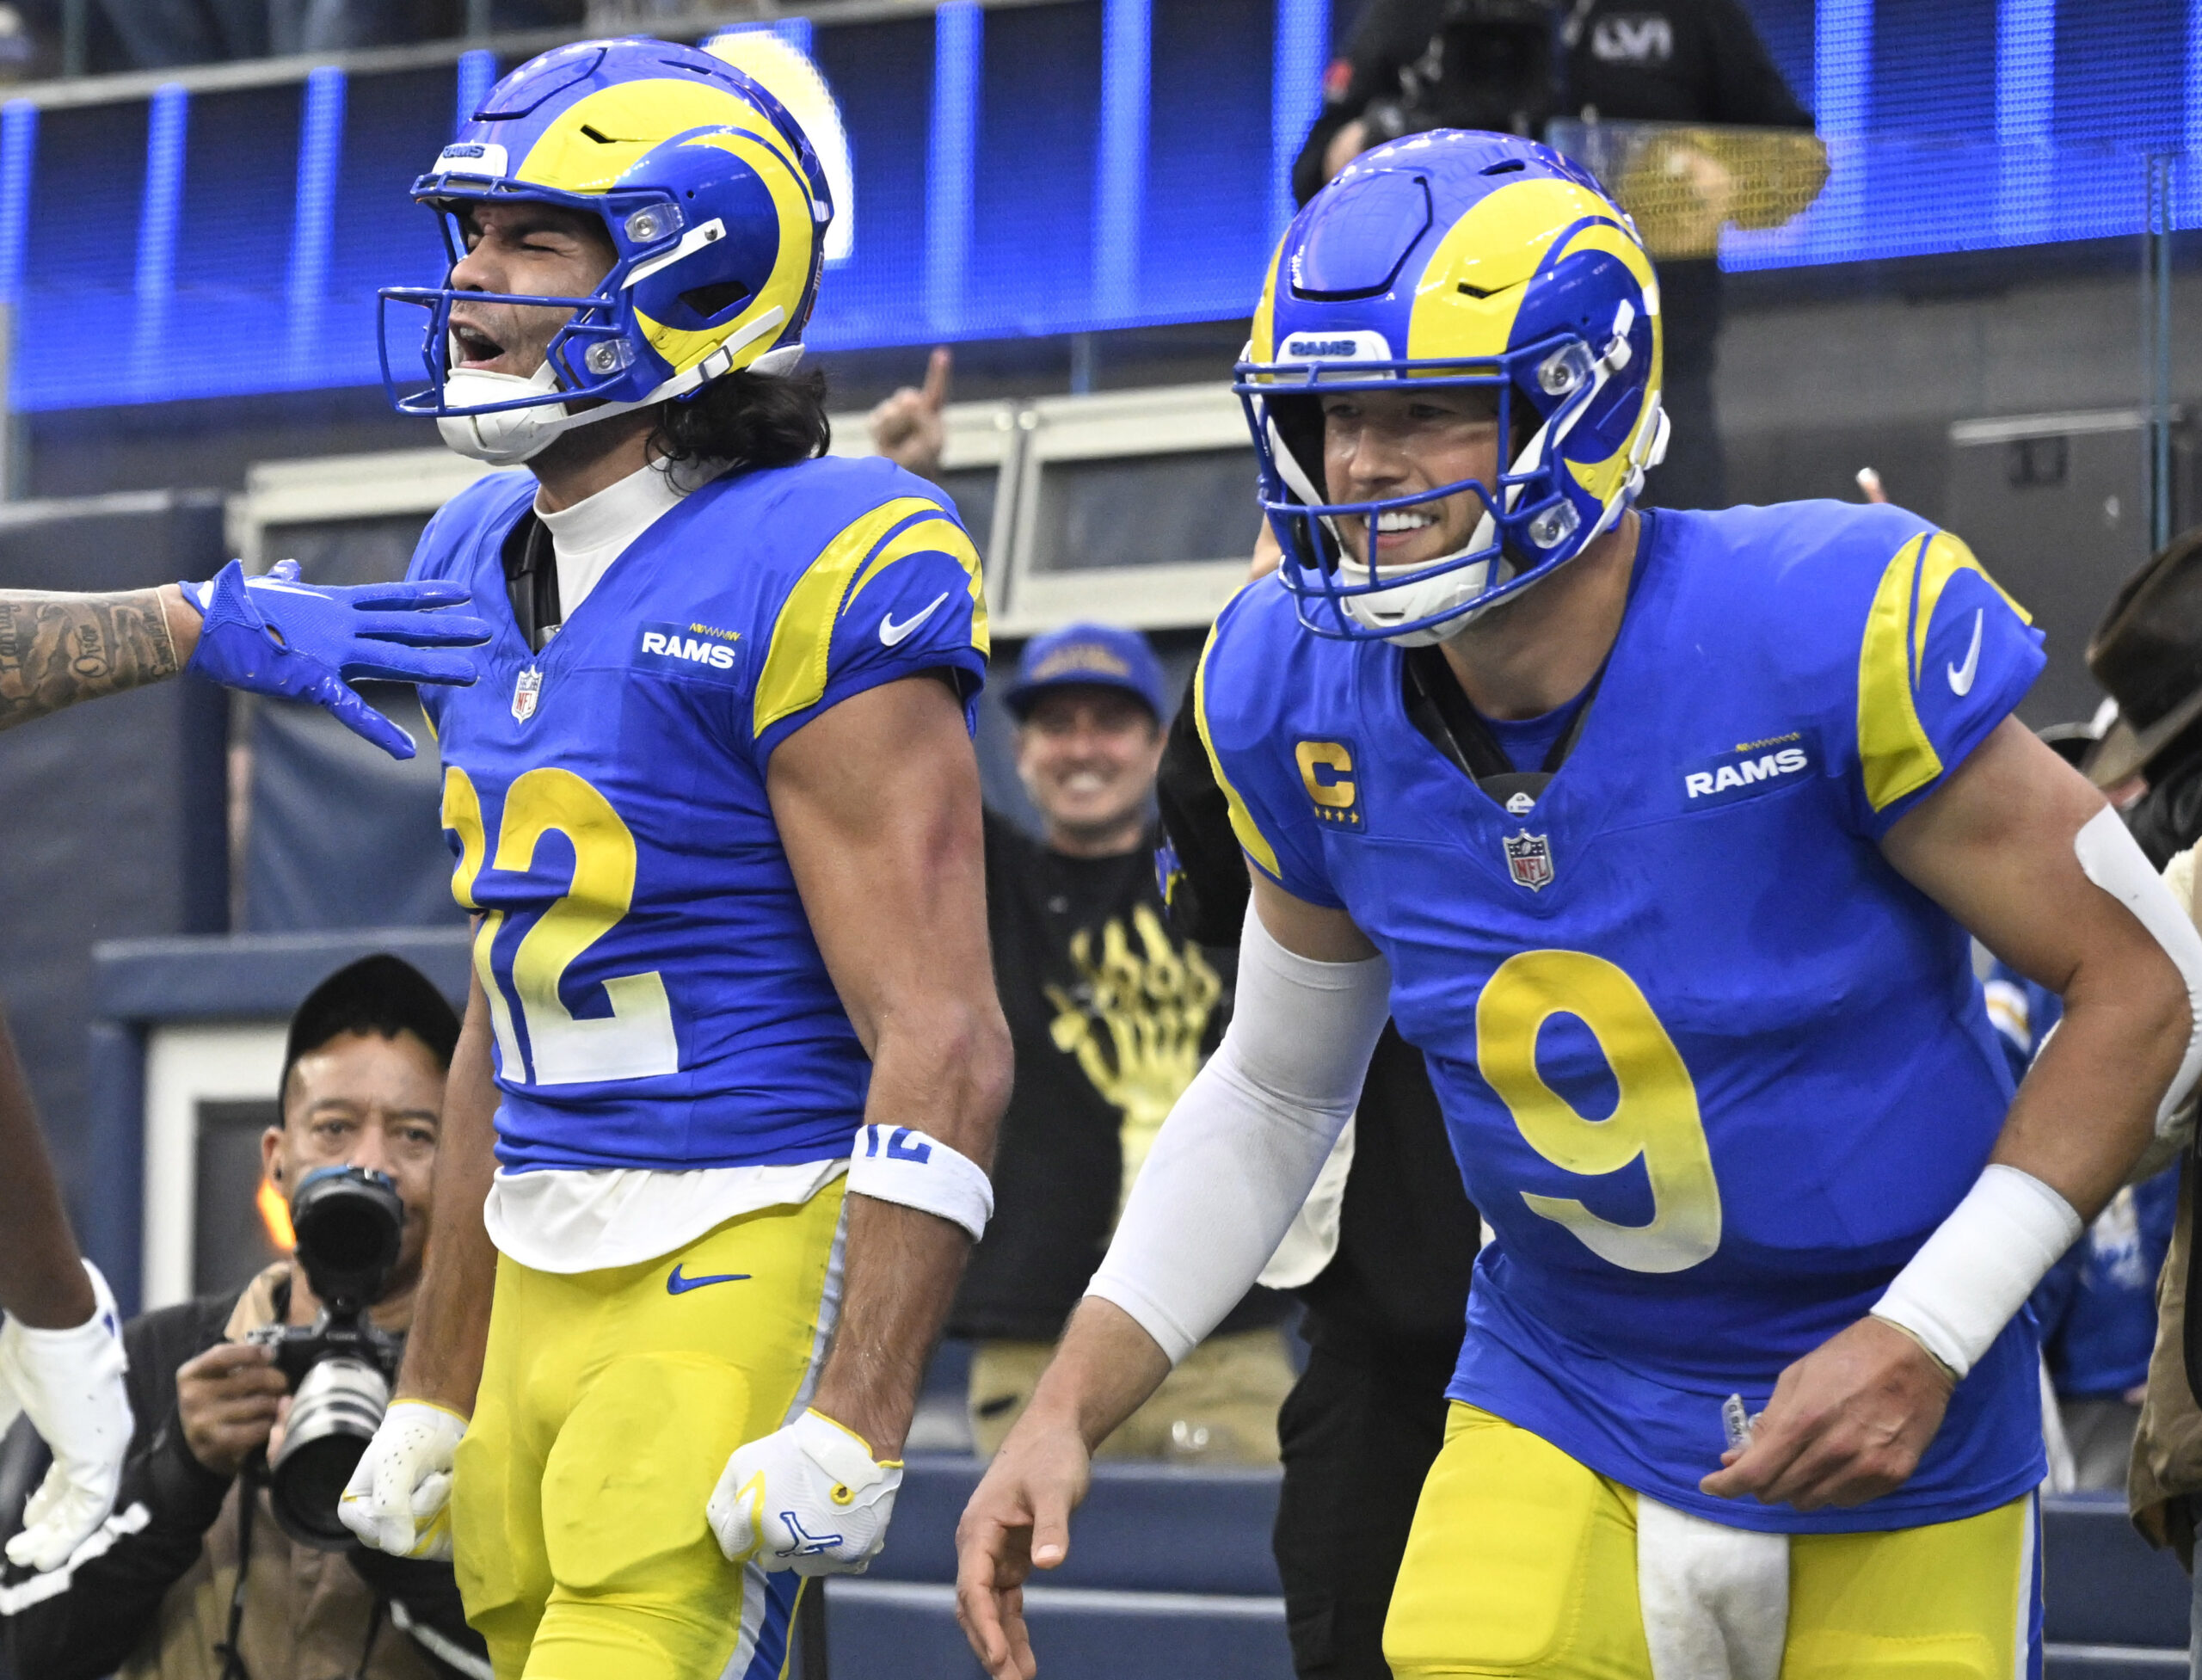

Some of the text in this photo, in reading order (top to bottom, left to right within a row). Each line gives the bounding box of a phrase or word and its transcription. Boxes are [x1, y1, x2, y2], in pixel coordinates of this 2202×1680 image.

[1289, 340, 1356, 356] RAMS
[642, 631, 735, 669] RAMS
[516, 692, 533, 712] NFL
[1295, 742, 1356, 808] C
[1685, 748, 1808, 798] RAMS
[1514, 858, 1547, 881] NFL
[441, 766, 679, 1086] 12
[1476, 949, 1721, 1273] 9
